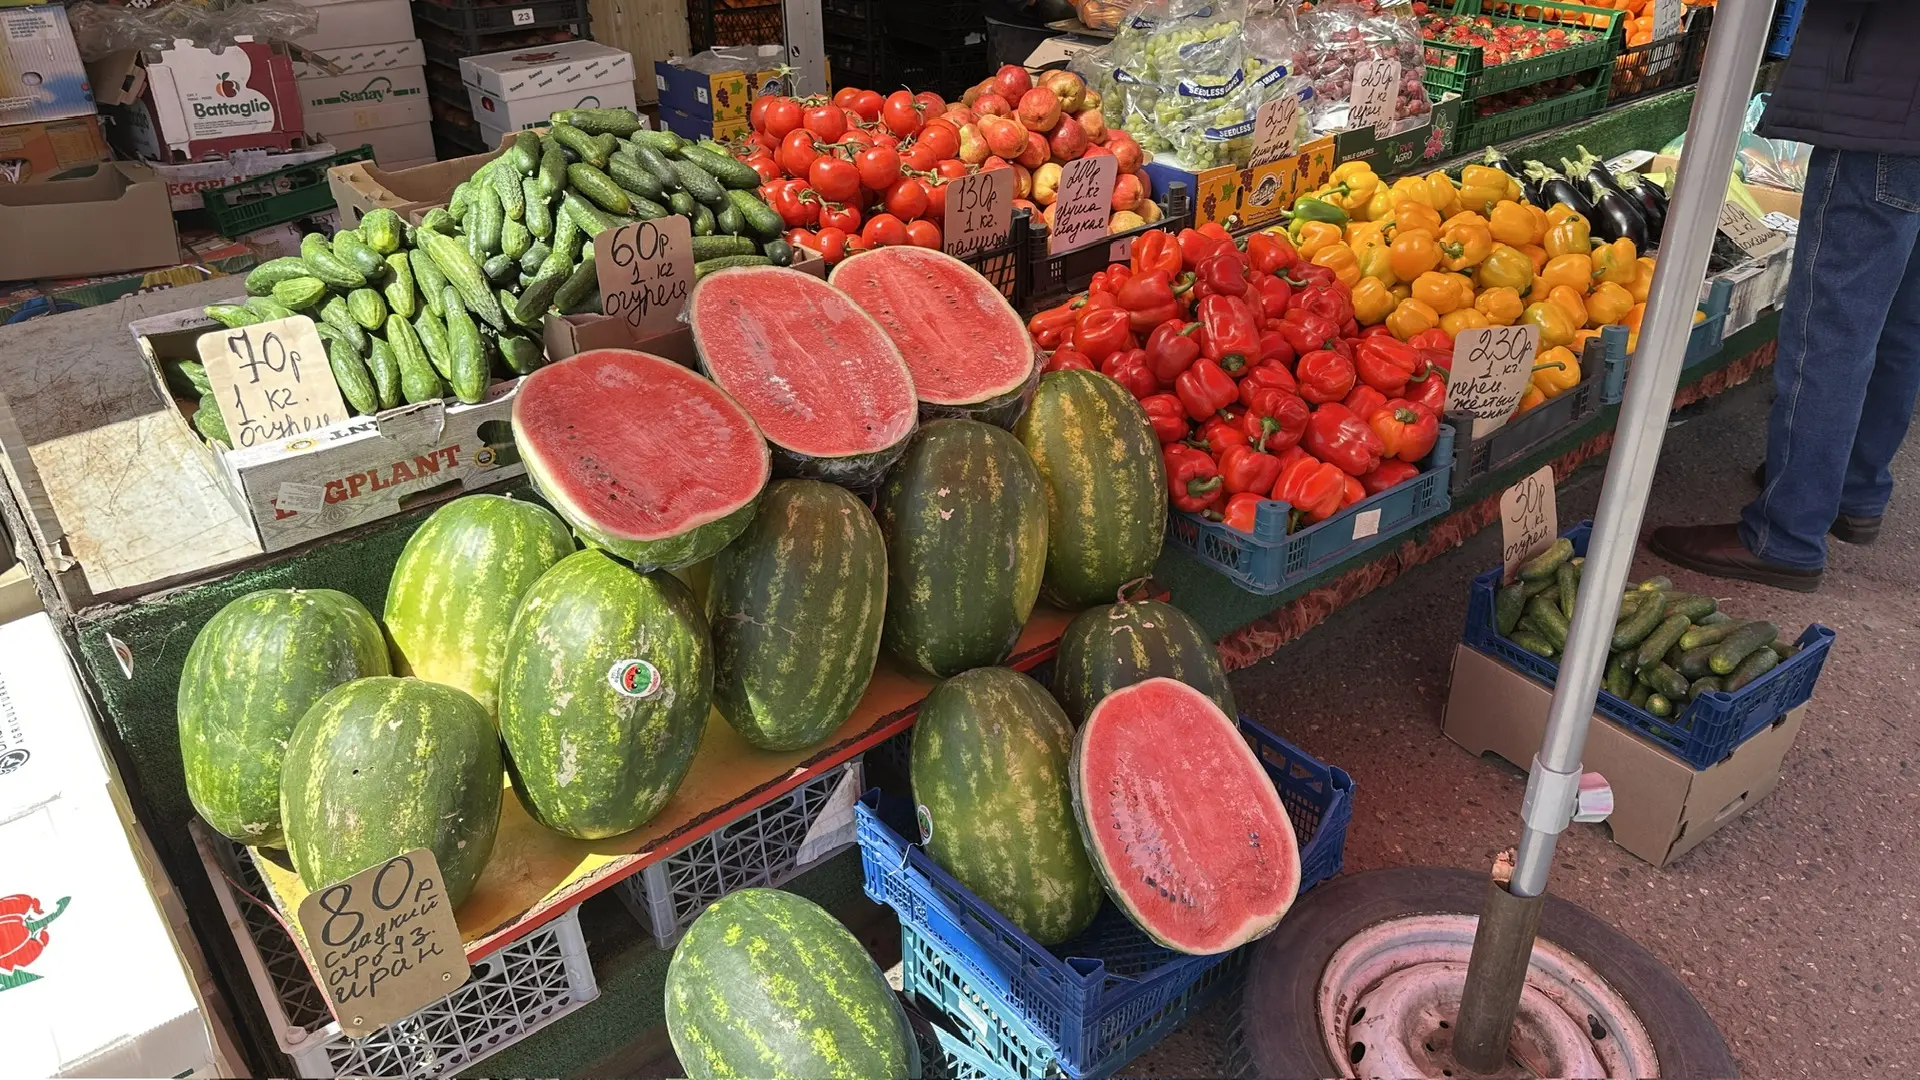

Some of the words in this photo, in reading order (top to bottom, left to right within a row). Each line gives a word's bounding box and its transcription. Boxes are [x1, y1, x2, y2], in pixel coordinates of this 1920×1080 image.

[517, 12, 531, 22] 23
[339, 89, 385, 103] Sanay
[1188, 86, 1224, 97] SEEDLESS
[192, 97, 271, 118] Battaglio
[1219, 123, 1253, 137] SEEDLESS
[1341, 152, 1357, 161] TABLE
[1357, 148, 1375, 159] GRAPES
[1393, 150, 1413, 164] AGRO
